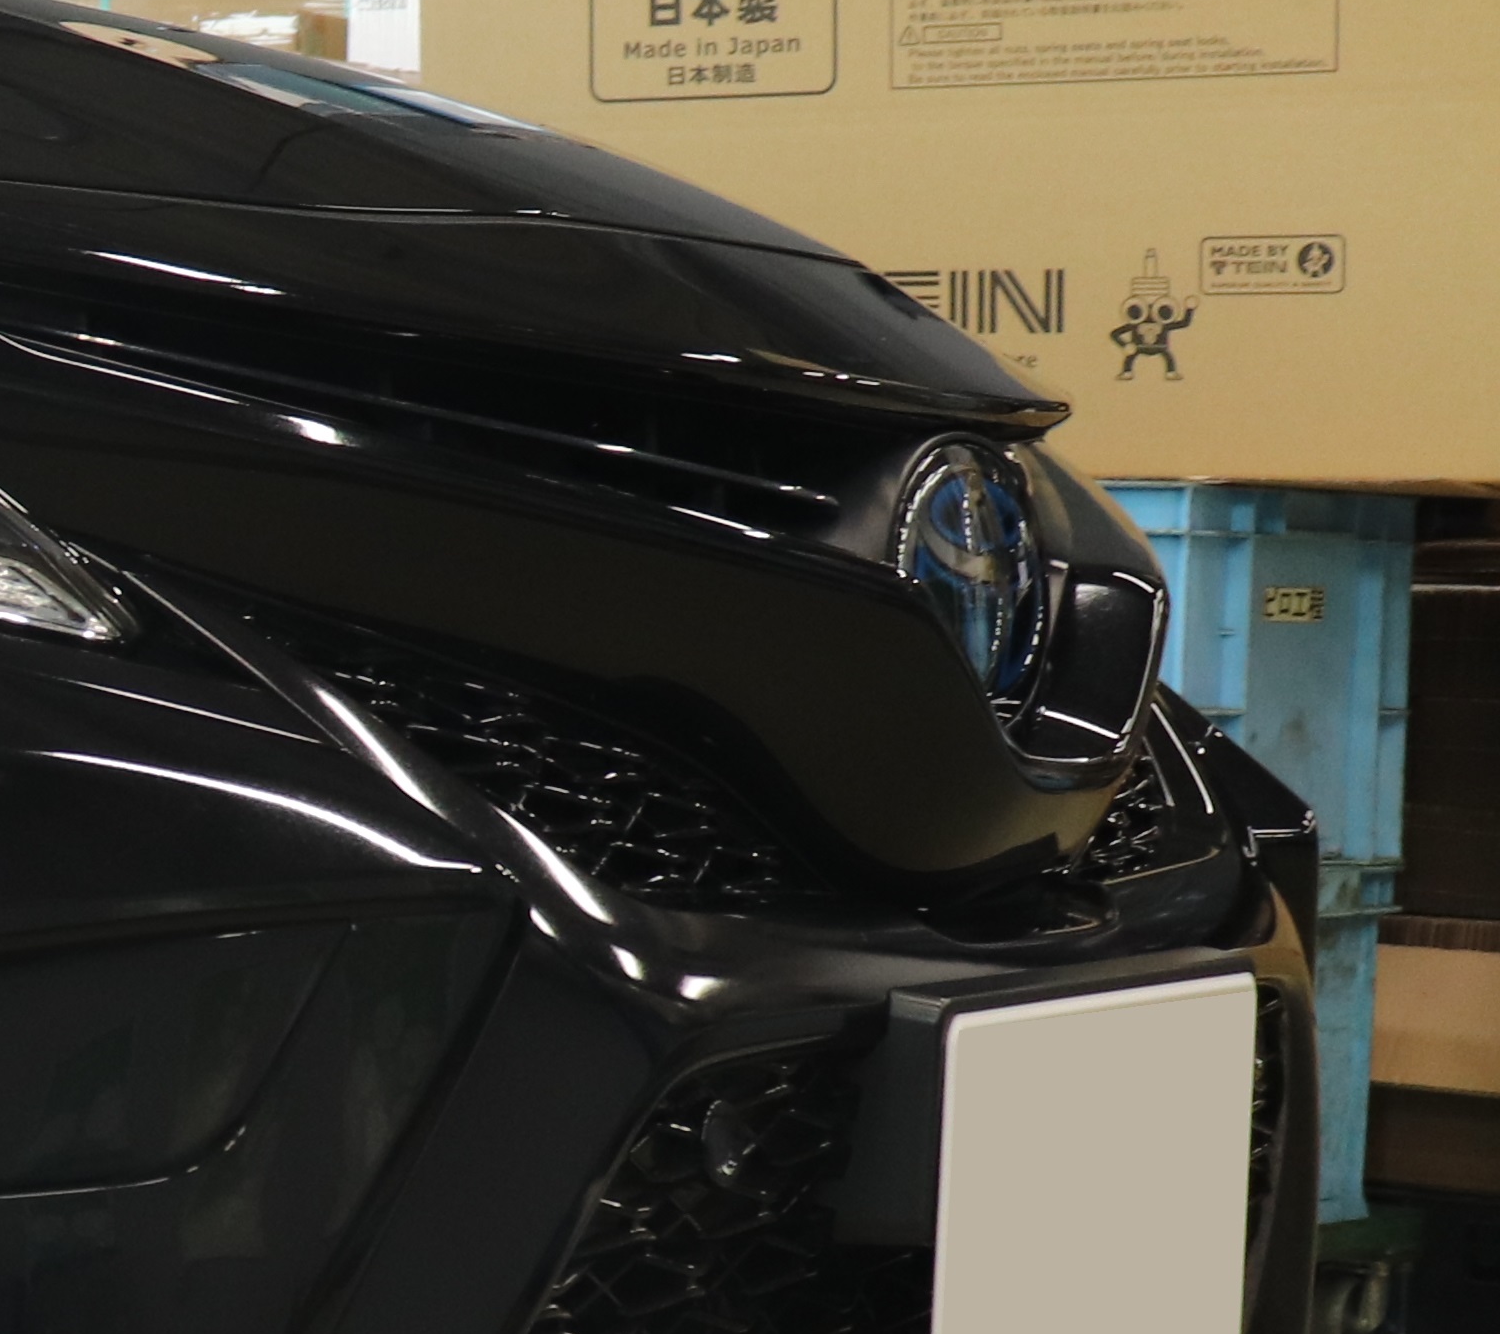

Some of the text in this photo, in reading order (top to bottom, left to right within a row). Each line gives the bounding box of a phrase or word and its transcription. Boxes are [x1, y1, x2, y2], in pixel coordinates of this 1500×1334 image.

[623, 36, 801, 60] Made in Japan
[667, 64, 756, 87] 日本制造
[1210, 244, 1290, 258] MADE BY
[1230, 260, 1289, 274] TEIN
